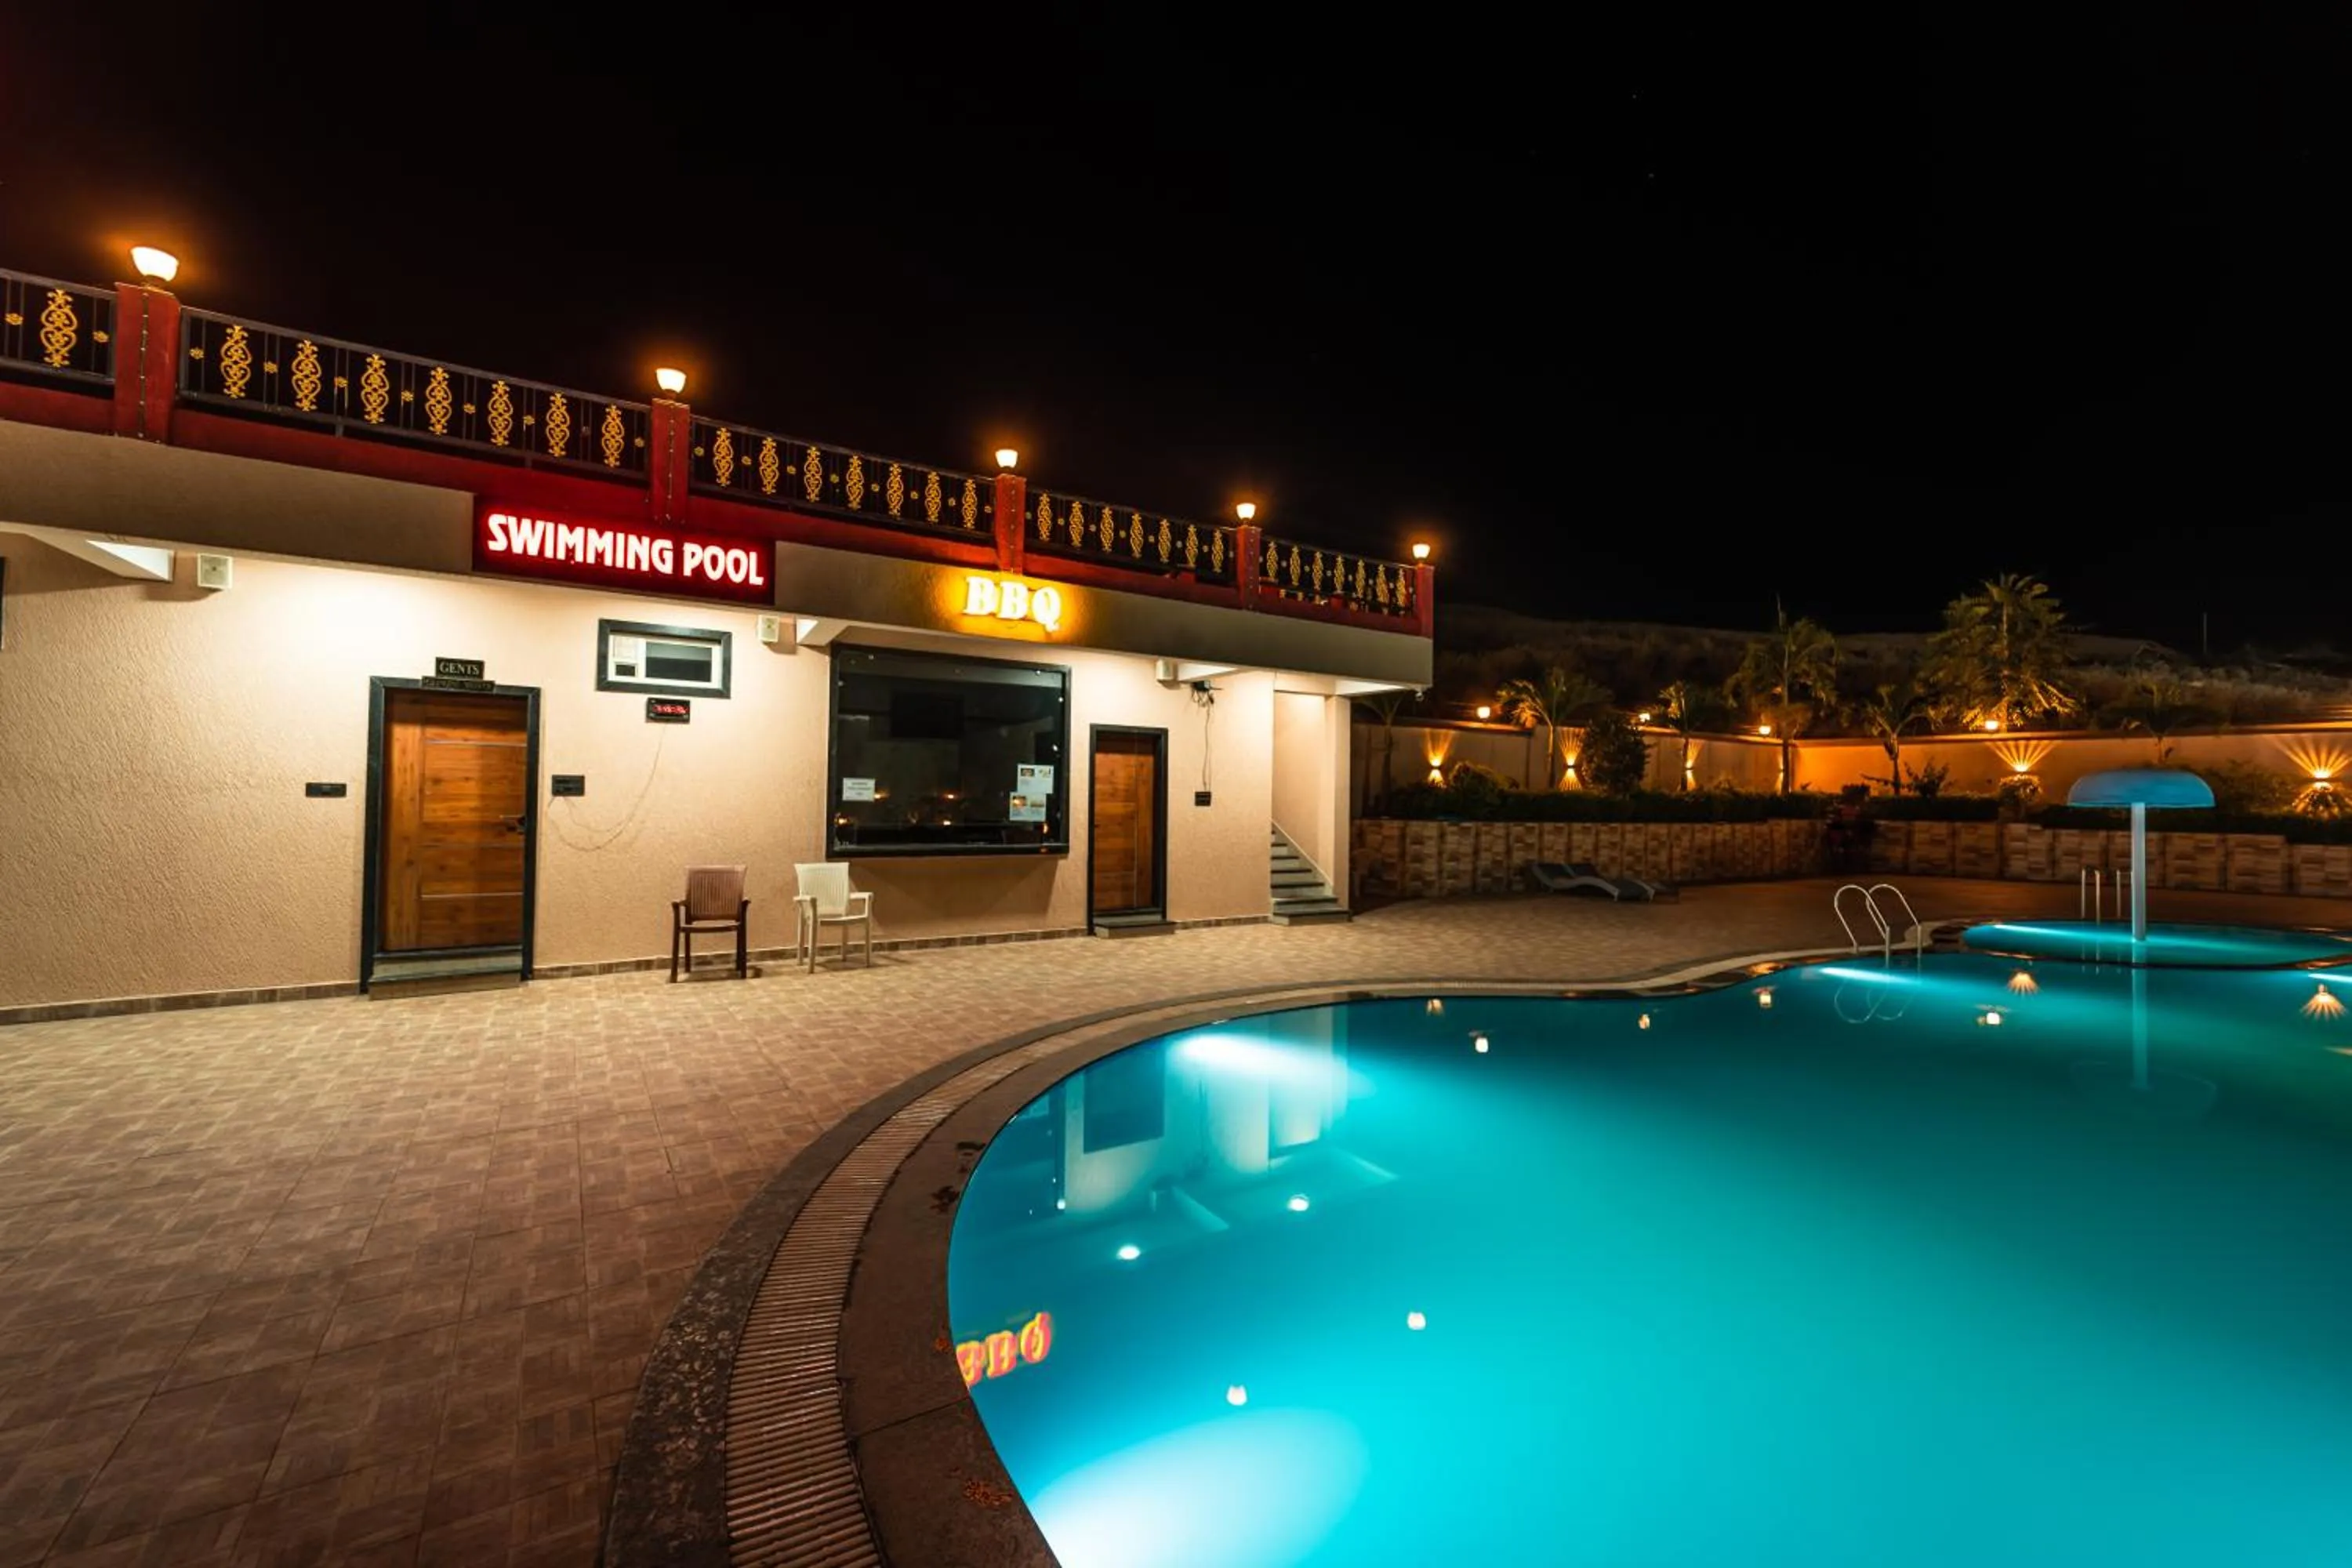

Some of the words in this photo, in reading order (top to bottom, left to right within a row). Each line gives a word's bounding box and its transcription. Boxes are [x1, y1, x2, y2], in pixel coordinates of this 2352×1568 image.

[487, 513, 673, 575] SWIMMING
[682, 542, 764, 586] POOL
[963, 575, 1062, 633] BBQ
[439, 661, 480, 675] GENTS
